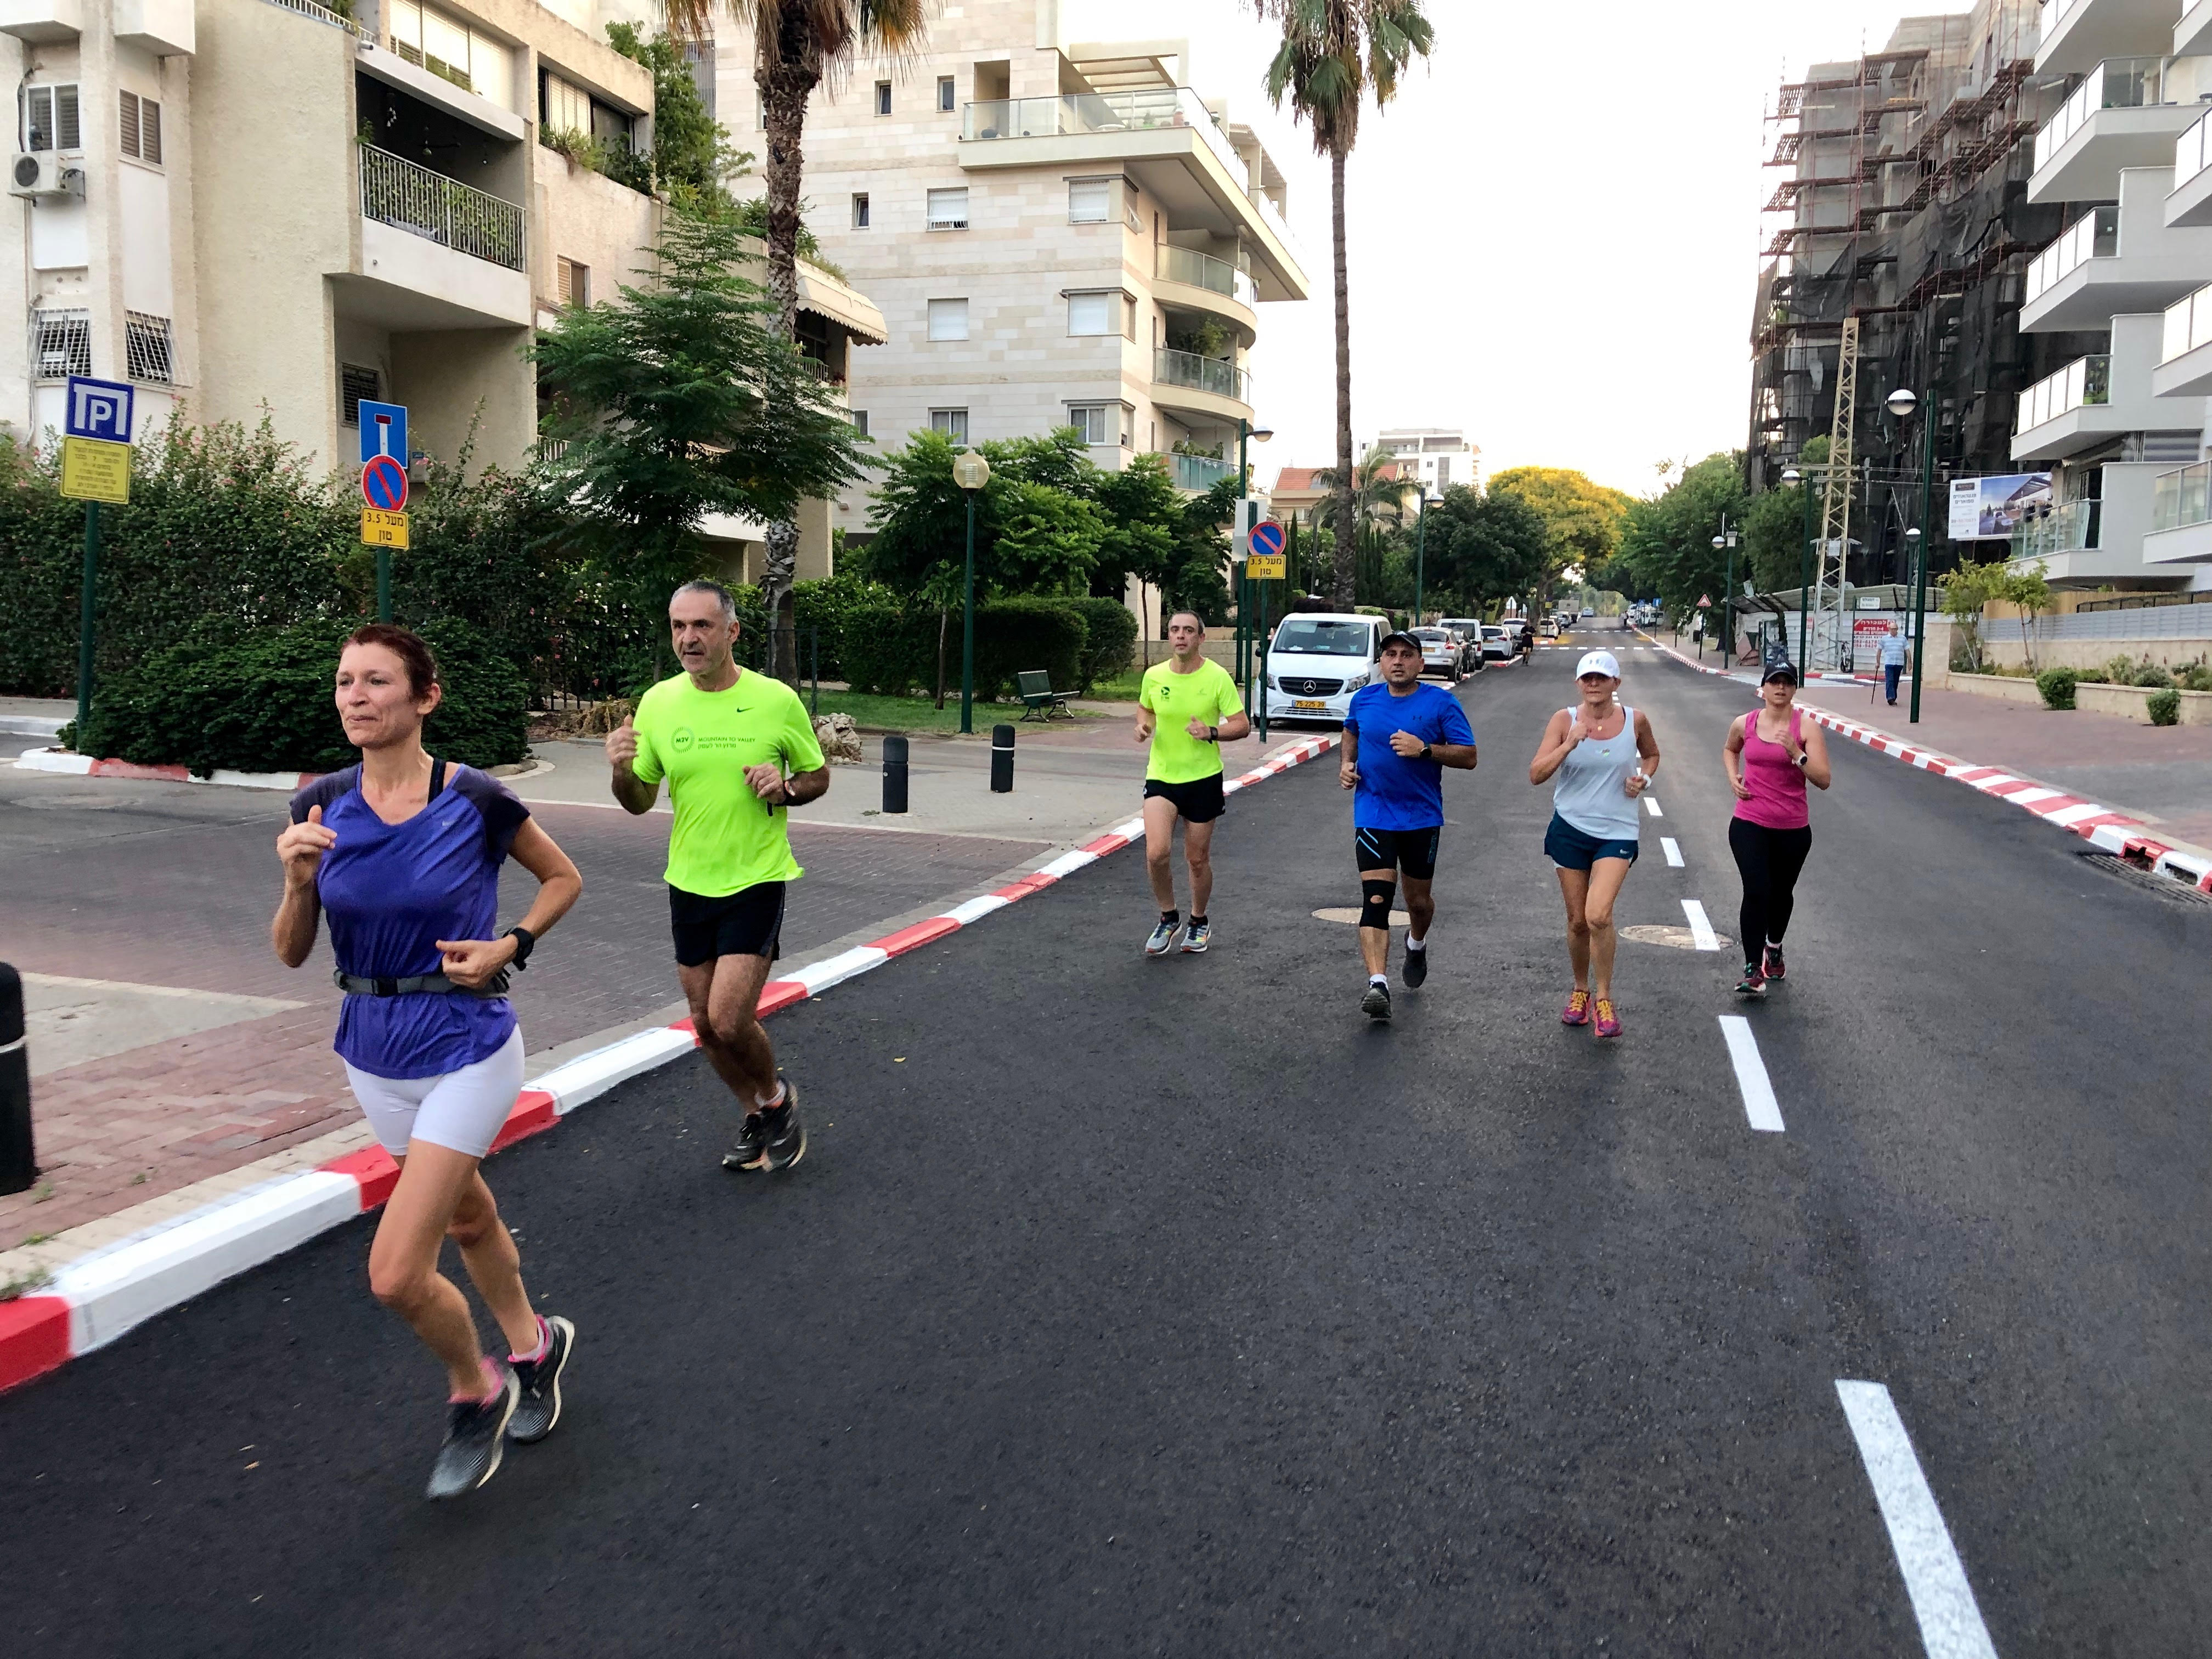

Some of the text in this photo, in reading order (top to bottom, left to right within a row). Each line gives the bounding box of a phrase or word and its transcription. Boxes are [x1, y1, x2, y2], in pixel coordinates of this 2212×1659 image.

[89, 399, 111, 431] P
[367, 512, 404, 527] מעל 3.5
[379, 529, 392, 542] טון
[1265, 556, 1282, 565] מעל
[1260, 568, 1272, 576] טון
